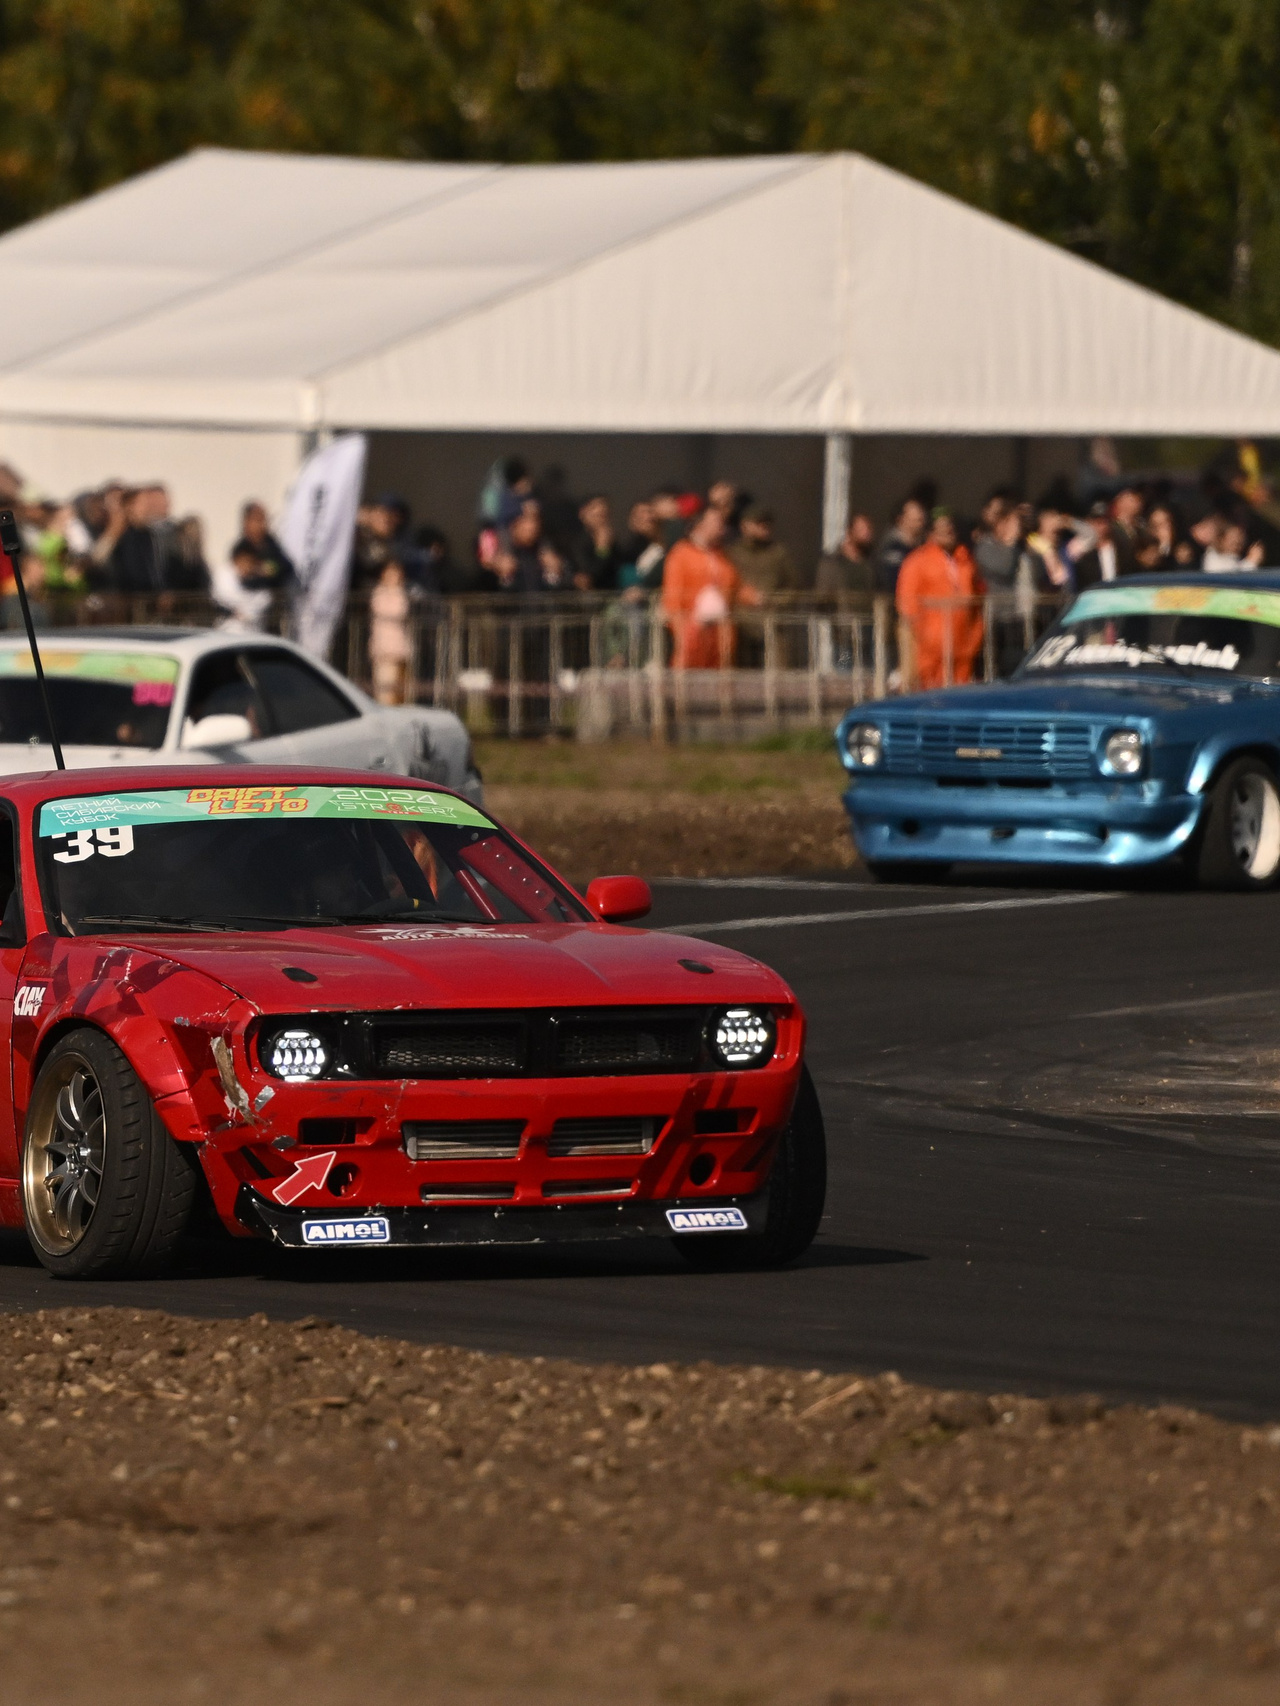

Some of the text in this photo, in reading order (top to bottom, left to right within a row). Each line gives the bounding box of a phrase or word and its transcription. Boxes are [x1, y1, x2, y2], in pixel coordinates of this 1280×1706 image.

[186, 786, 298, 803] DRIFT
[333, 789, 438, 805] 2024
[51, 797, 122, 813] ЛЕТНИЙ
[55, 801, 162, 820] СИБИРСКИЙ
[208, 798, 308, 815] LETO
[60, 813, 120, 827] КУБОК
[51, 825, 134, 864] 39
[673, 1212, 742, 1228] AIMOL
[307, 1223, 385, 1240] AIMOL
